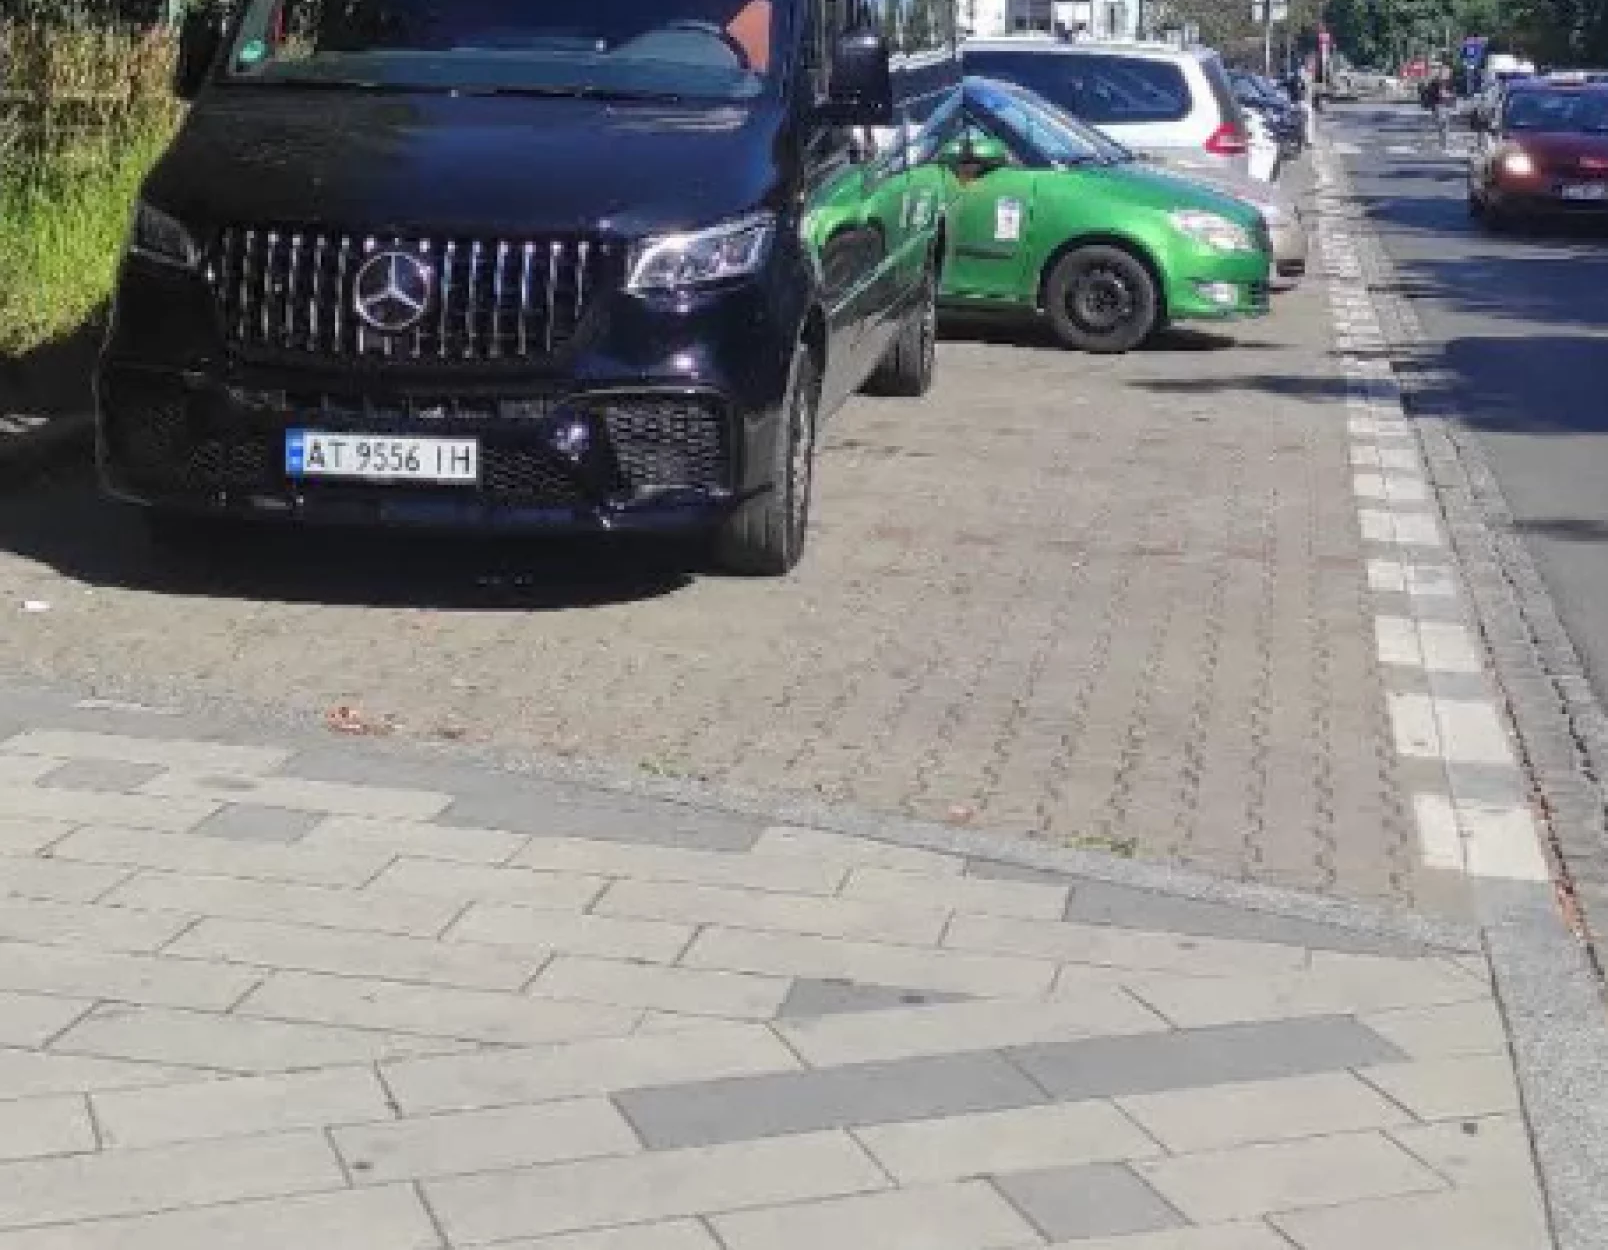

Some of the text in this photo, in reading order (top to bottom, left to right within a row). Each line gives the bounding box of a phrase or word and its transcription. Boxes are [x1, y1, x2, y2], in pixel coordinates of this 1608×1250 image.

[306, 440, 470, 475] AT 9556 IH
